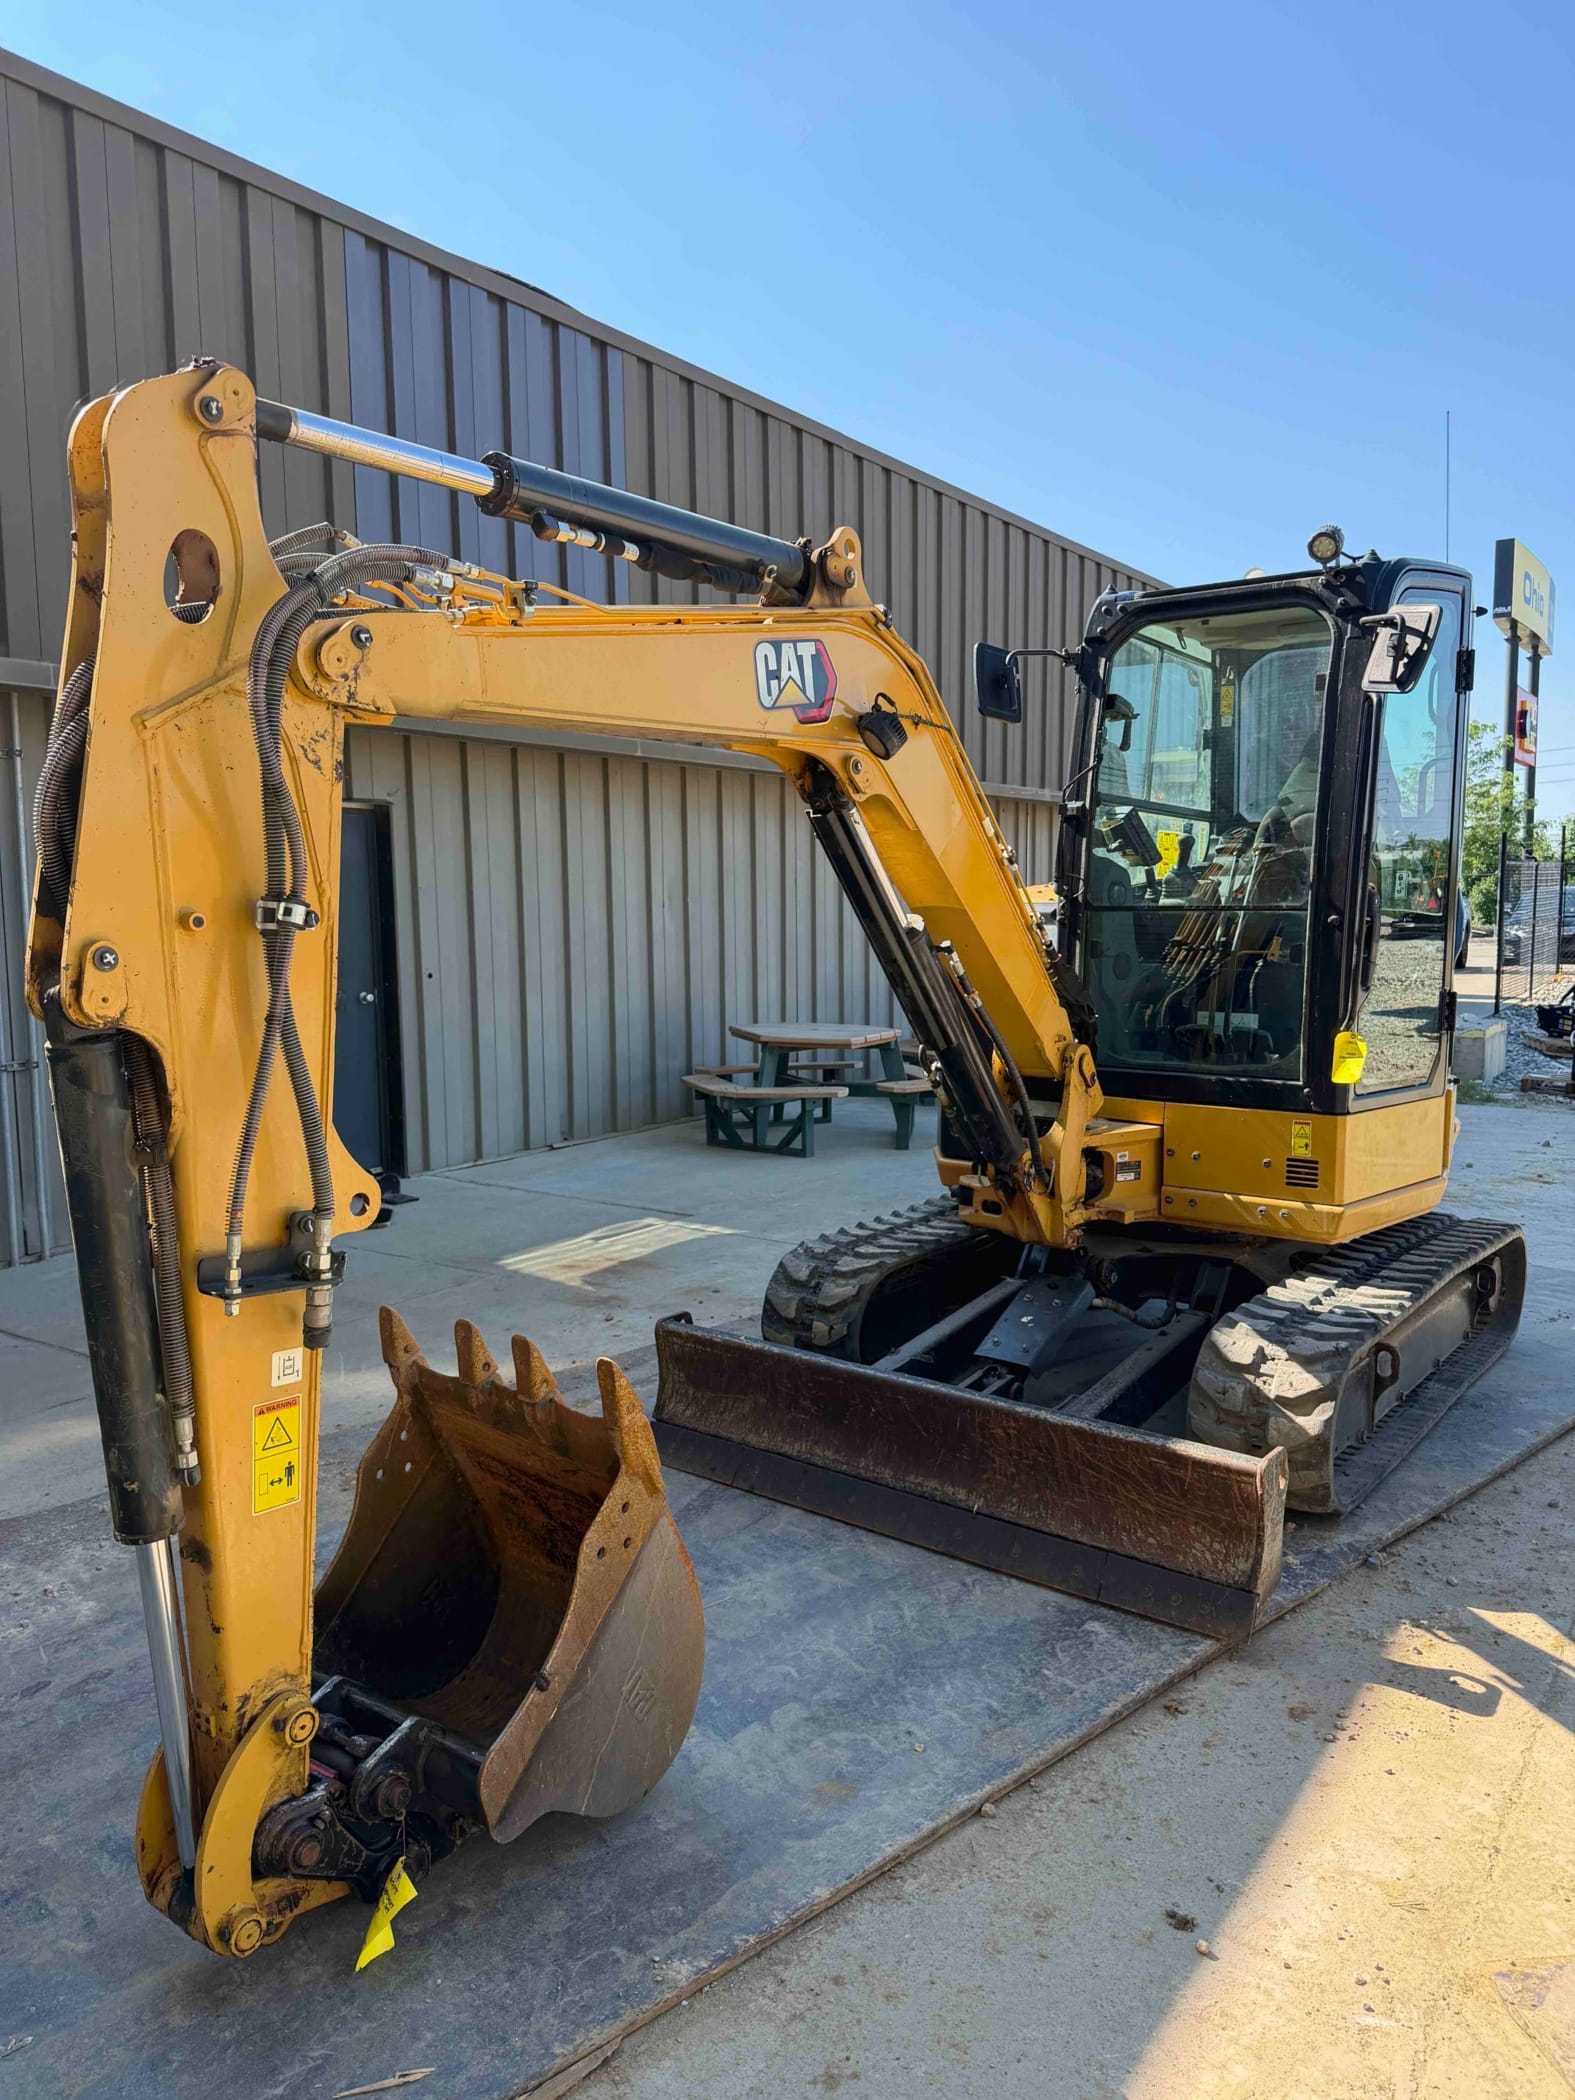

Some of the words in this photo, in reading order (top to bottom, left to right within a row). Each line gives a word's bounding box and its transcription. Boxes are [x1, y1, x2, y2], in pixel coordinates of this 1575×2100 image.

[1523, 570, 1544, 617] Ohio
[755, 641, 816, 708] CAT
[266, 1399, 297, 1413] WARNING
